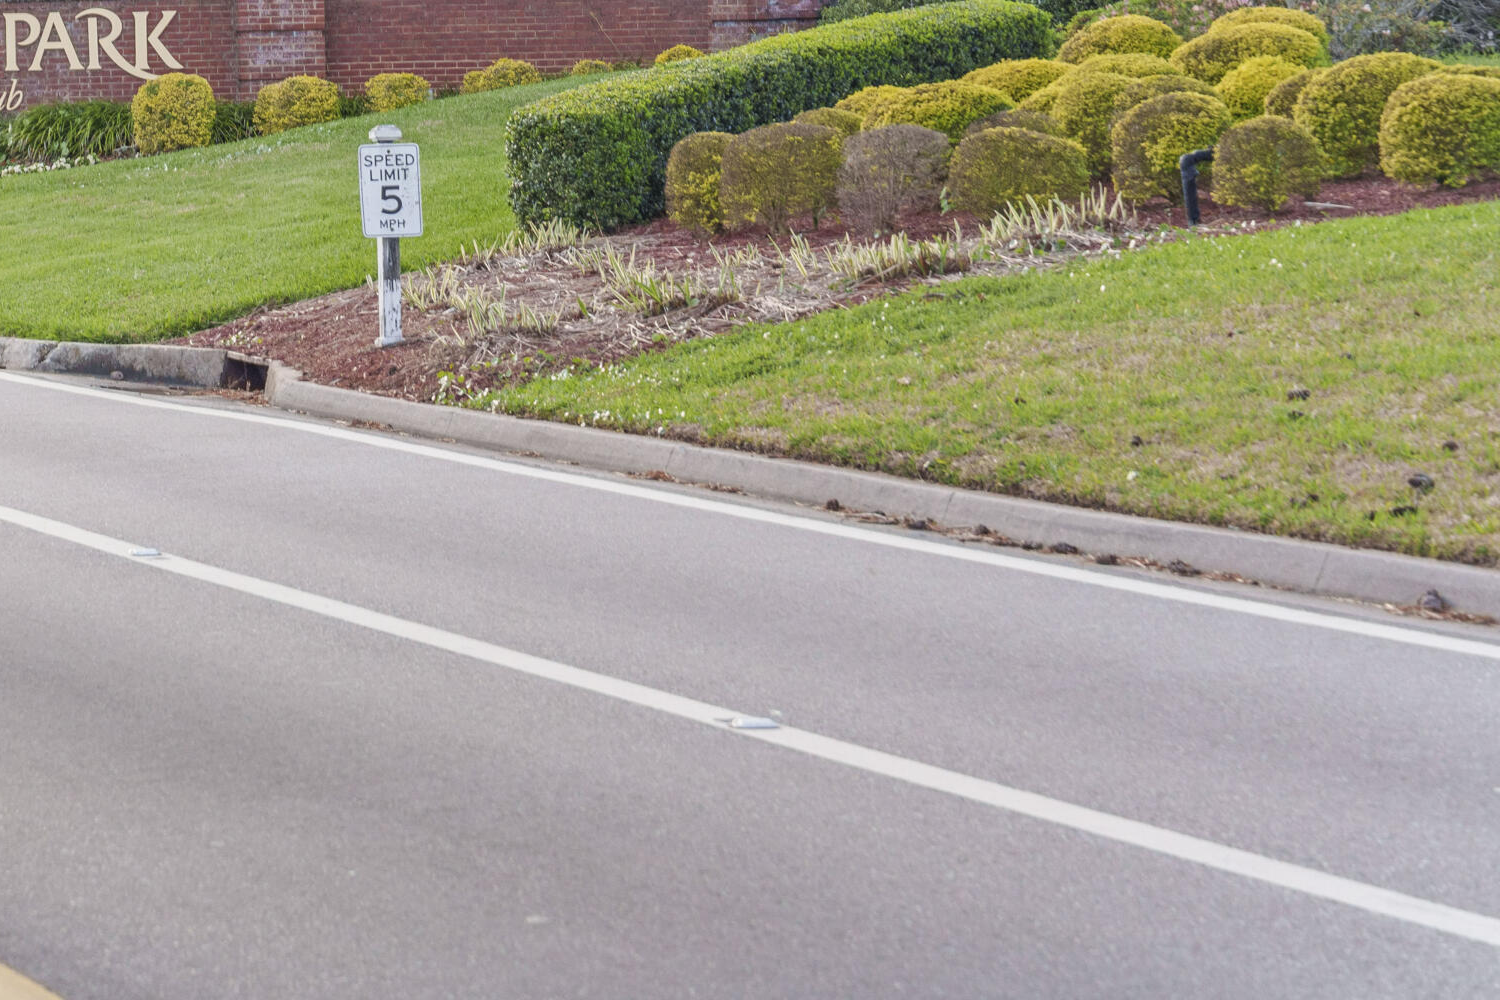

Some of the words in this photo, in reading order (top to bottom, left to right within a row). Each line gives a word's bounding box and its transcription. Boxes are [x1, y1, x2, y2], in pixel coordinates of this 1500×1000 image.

[2, 7, 184, 80] PARK
[363, 154, 415, 167] SPEED
[369, 168, 409, 181] LIMIT
[381, 185, 403, 214] 5
[380, 219, 405, 229] MPH
